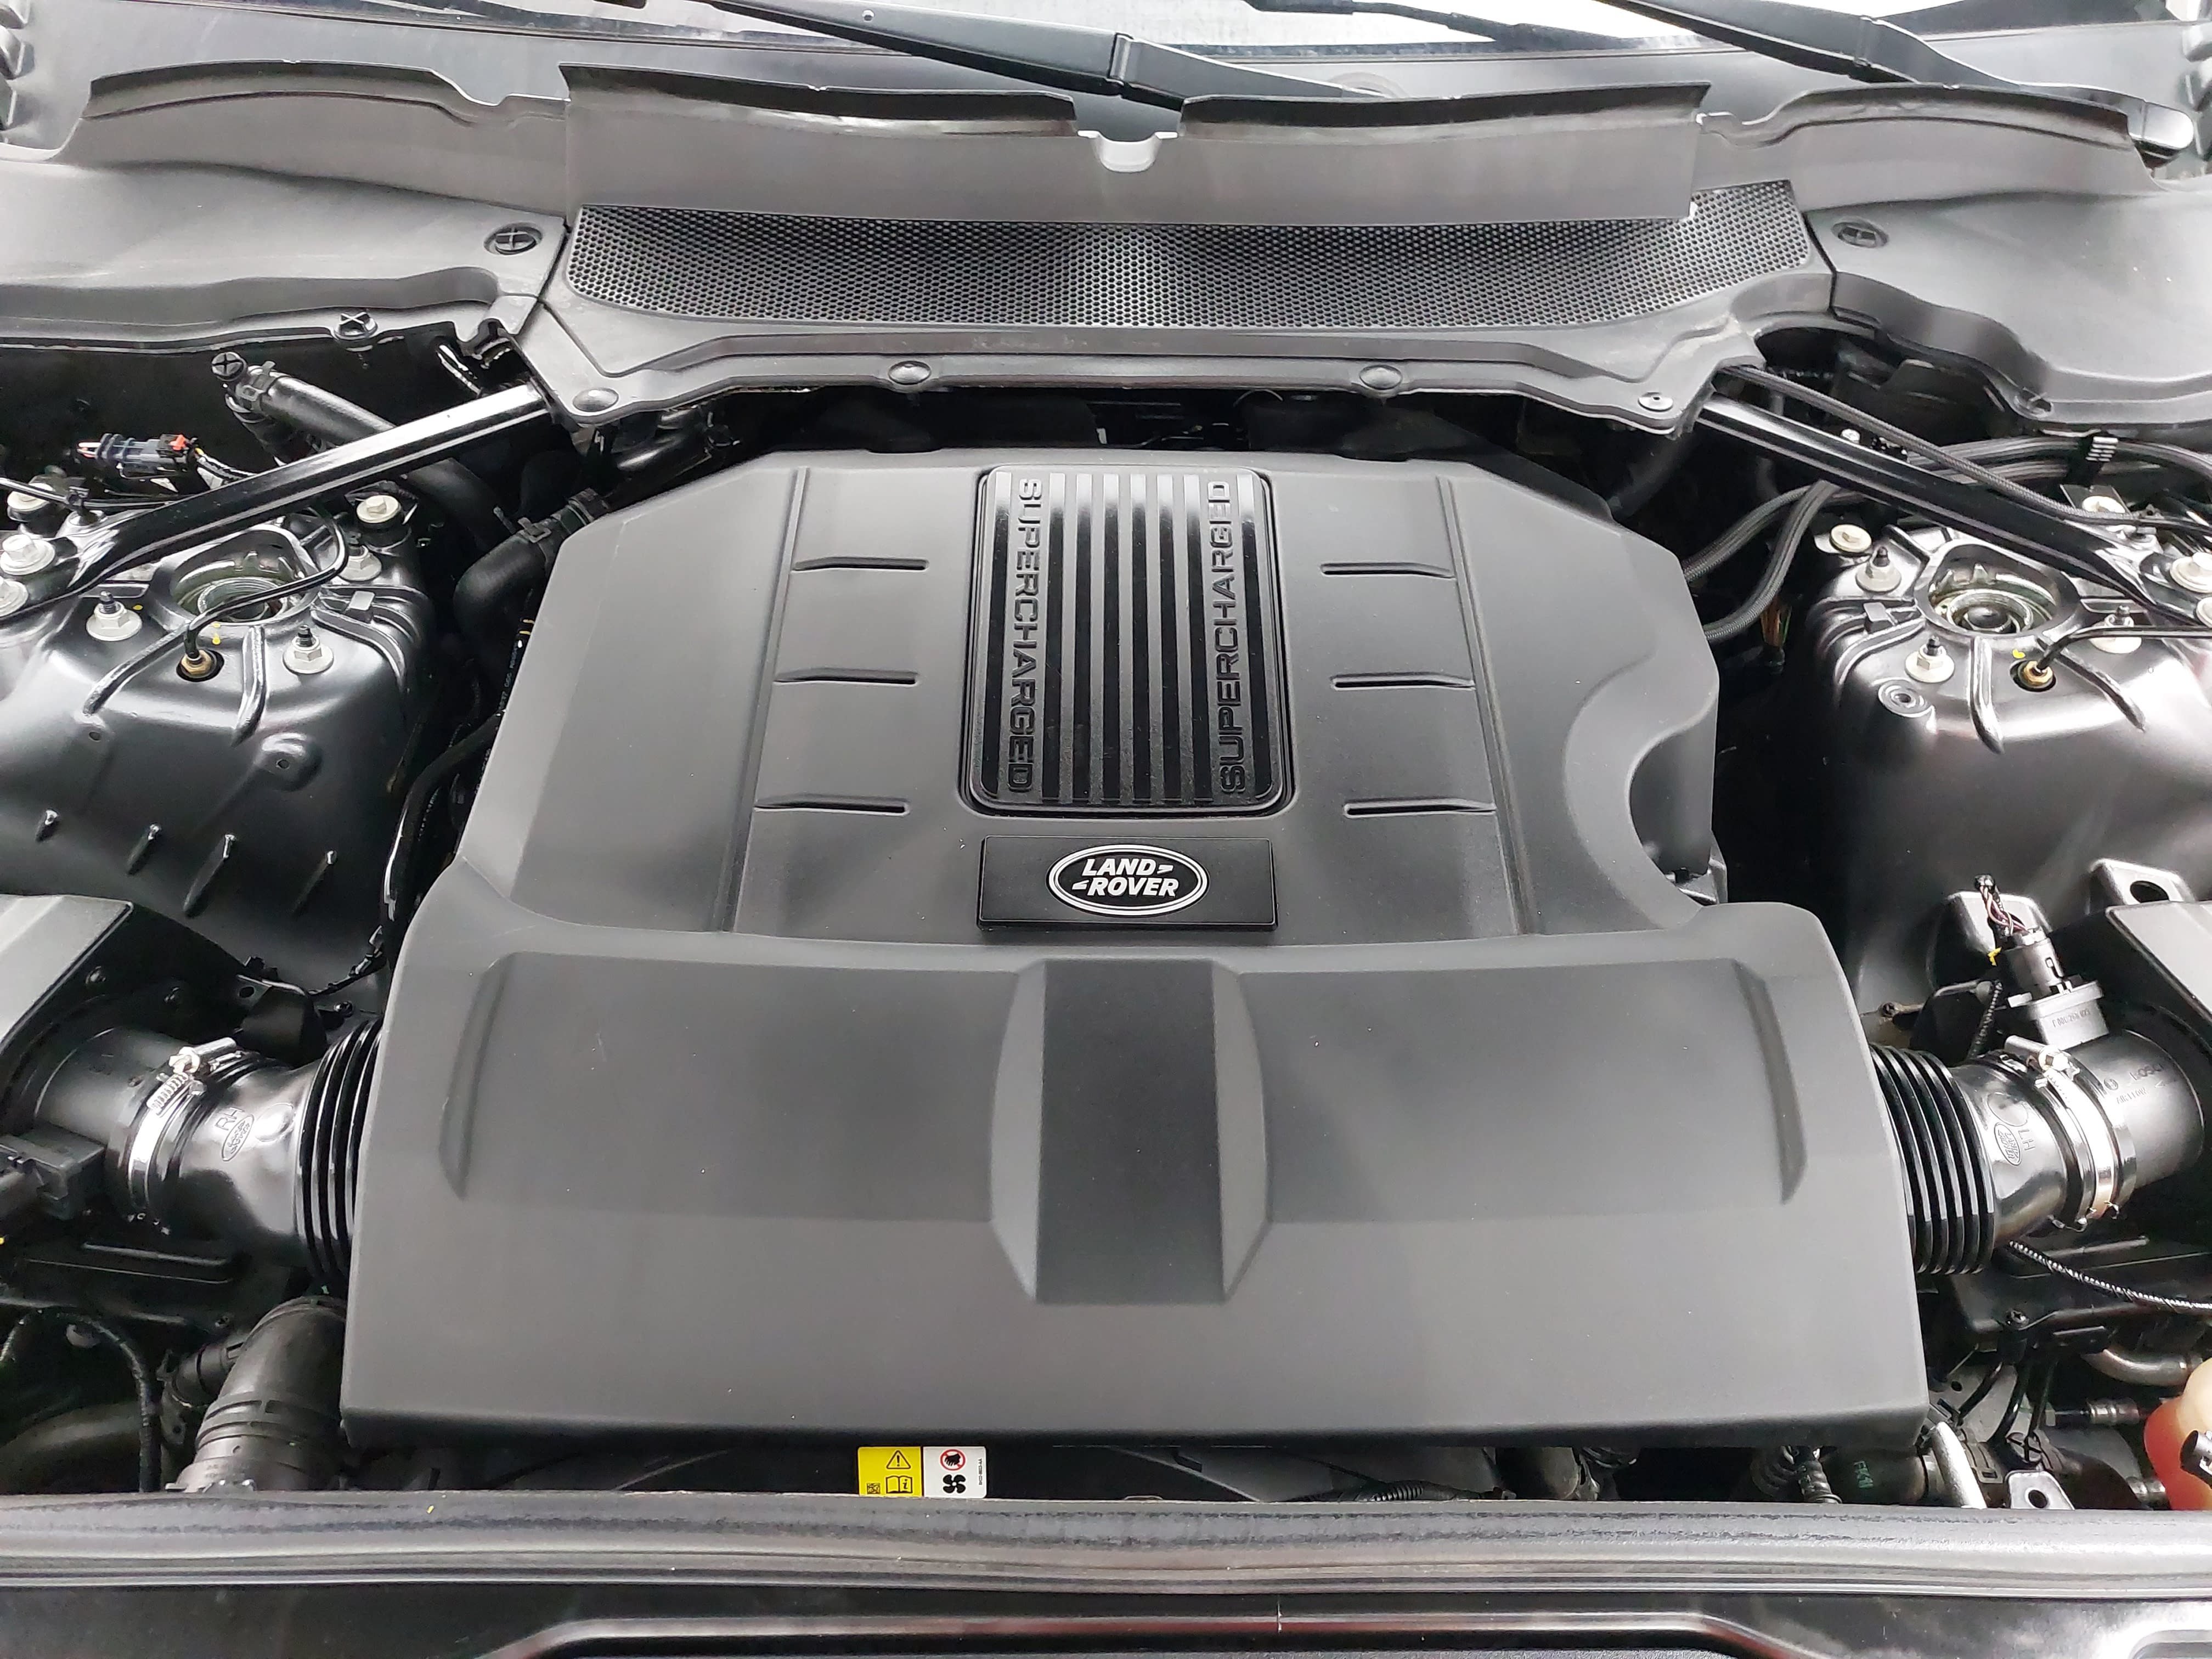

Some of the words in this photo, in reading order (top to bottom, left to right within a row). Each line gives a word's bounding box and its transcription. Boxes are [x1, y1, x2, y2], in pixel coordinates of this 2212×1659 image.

[1008, 478, 1042, 792] SUPERCHARGED
[1207, 481, 1246, 794] SUPERCHARGED
[1082, 858, 1156, 876] LAND
[1087, 877, 1179, 896] ROVER
[215, 1106, 246, 1131] RH
[2018, 1129, 2036, 1151] LH
